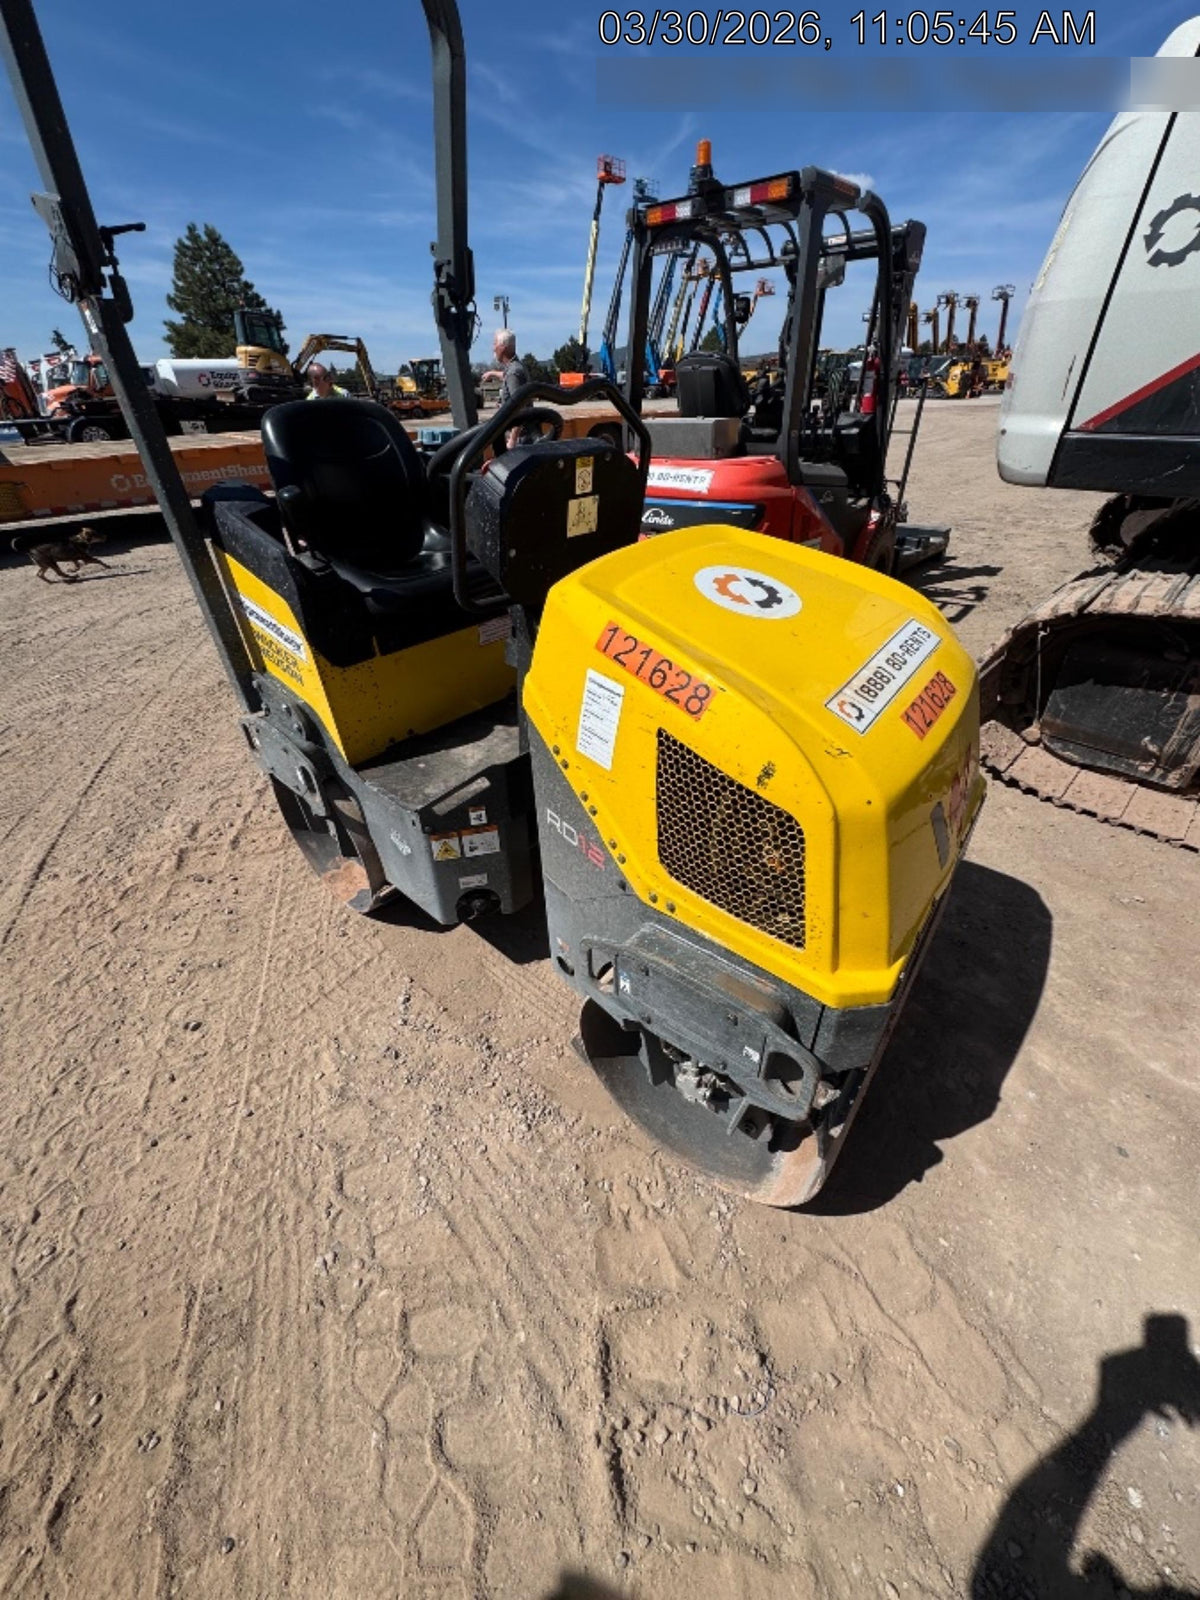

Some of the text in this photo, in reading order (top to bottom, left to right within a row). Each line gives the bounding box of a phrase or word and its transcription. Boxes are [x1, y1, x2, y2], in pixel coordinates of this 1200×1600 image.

[603, 625, 711, 715] 121628
[854, 626, 932, 703] (888) 80-RENTS
[904, 670, 957, 736] 121628
[546, 808, 606, 871] RD12
